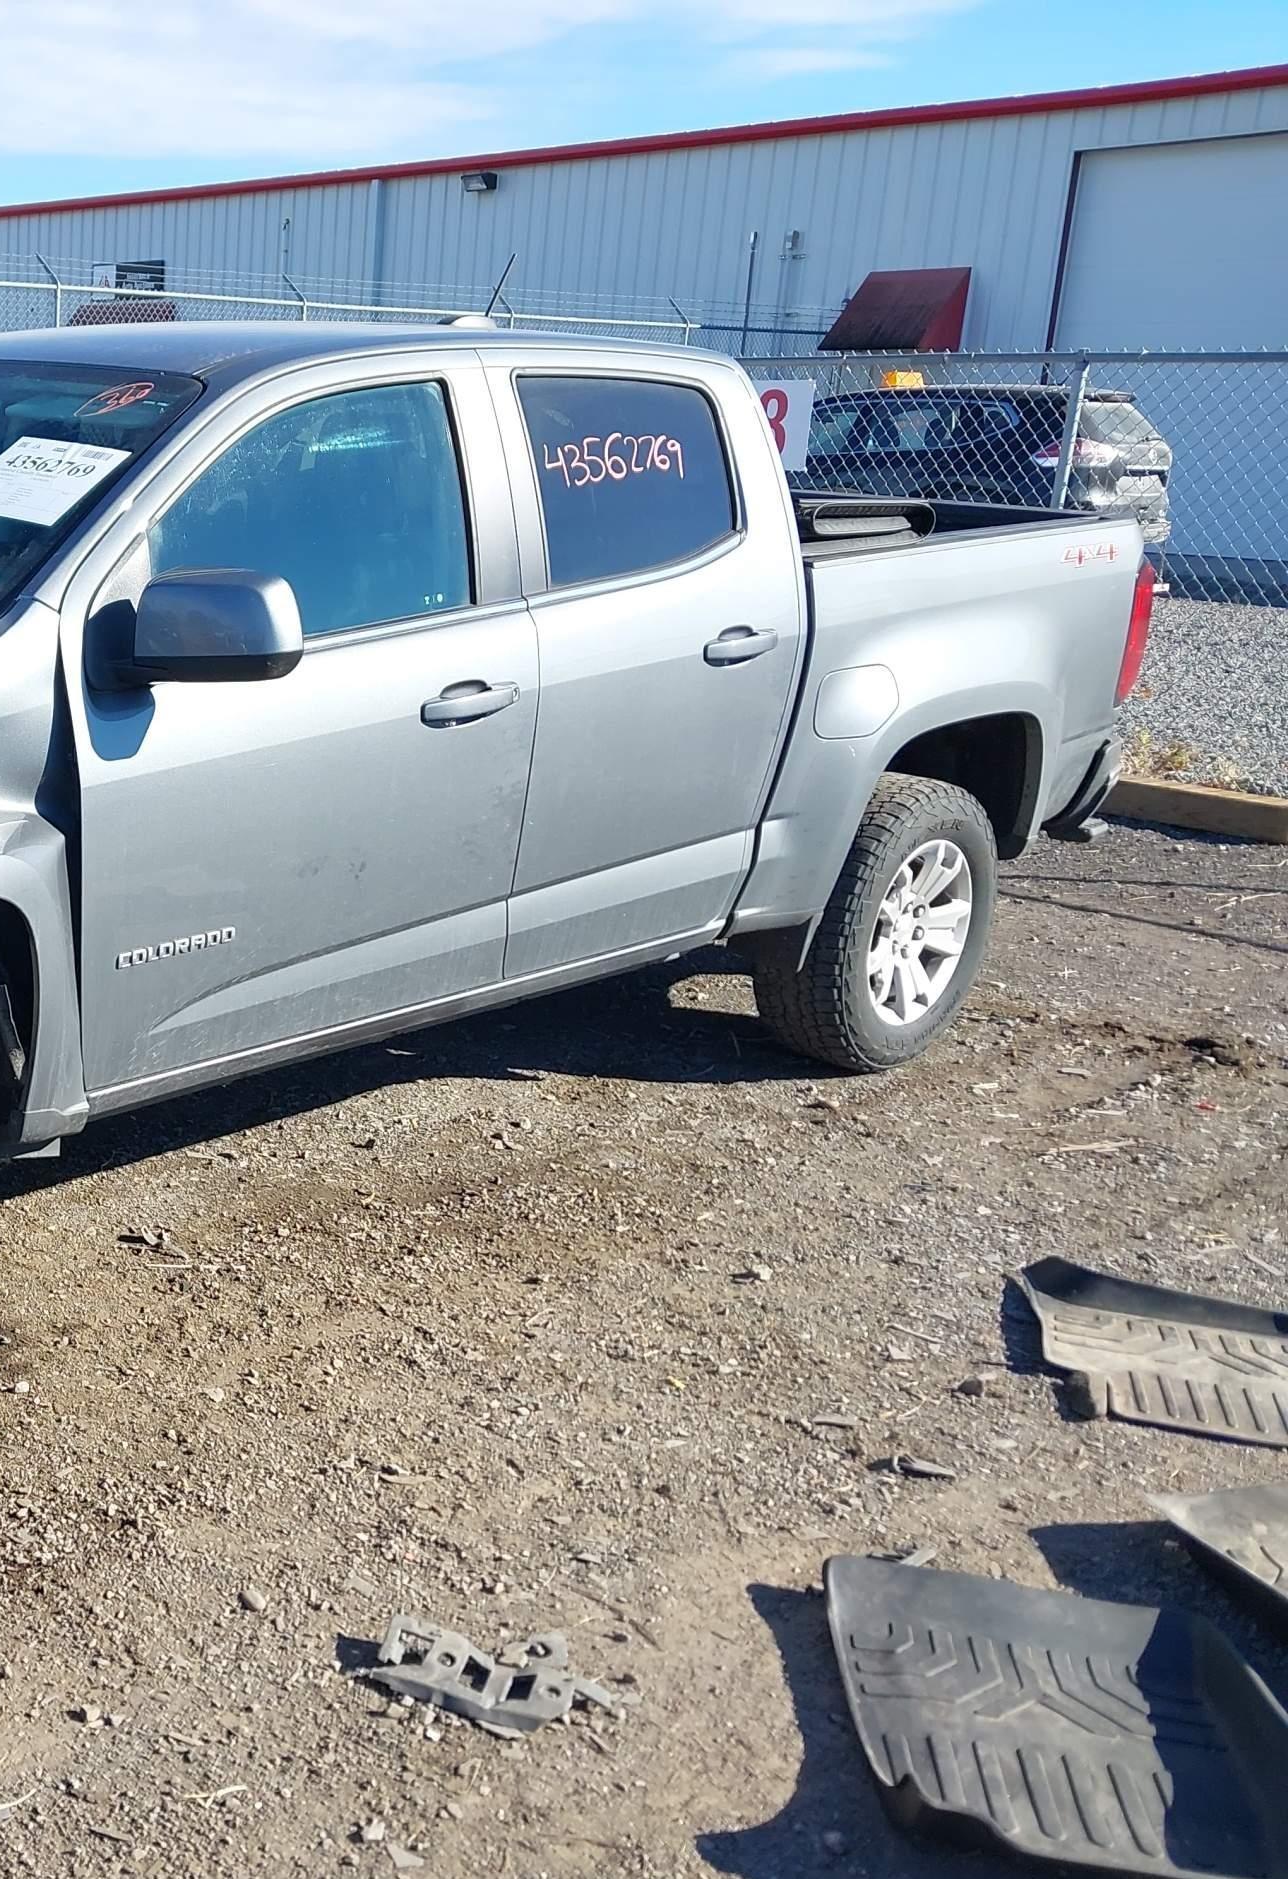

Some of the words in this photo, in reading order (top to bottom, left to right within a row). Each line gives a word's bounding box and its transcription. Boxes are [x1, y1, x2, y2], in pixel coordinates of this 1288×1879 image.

[6, 454, 96, 478] 43562769
[543, 432, 685, 488] 43562769
[115, 926, 237, 970] COLORADO
